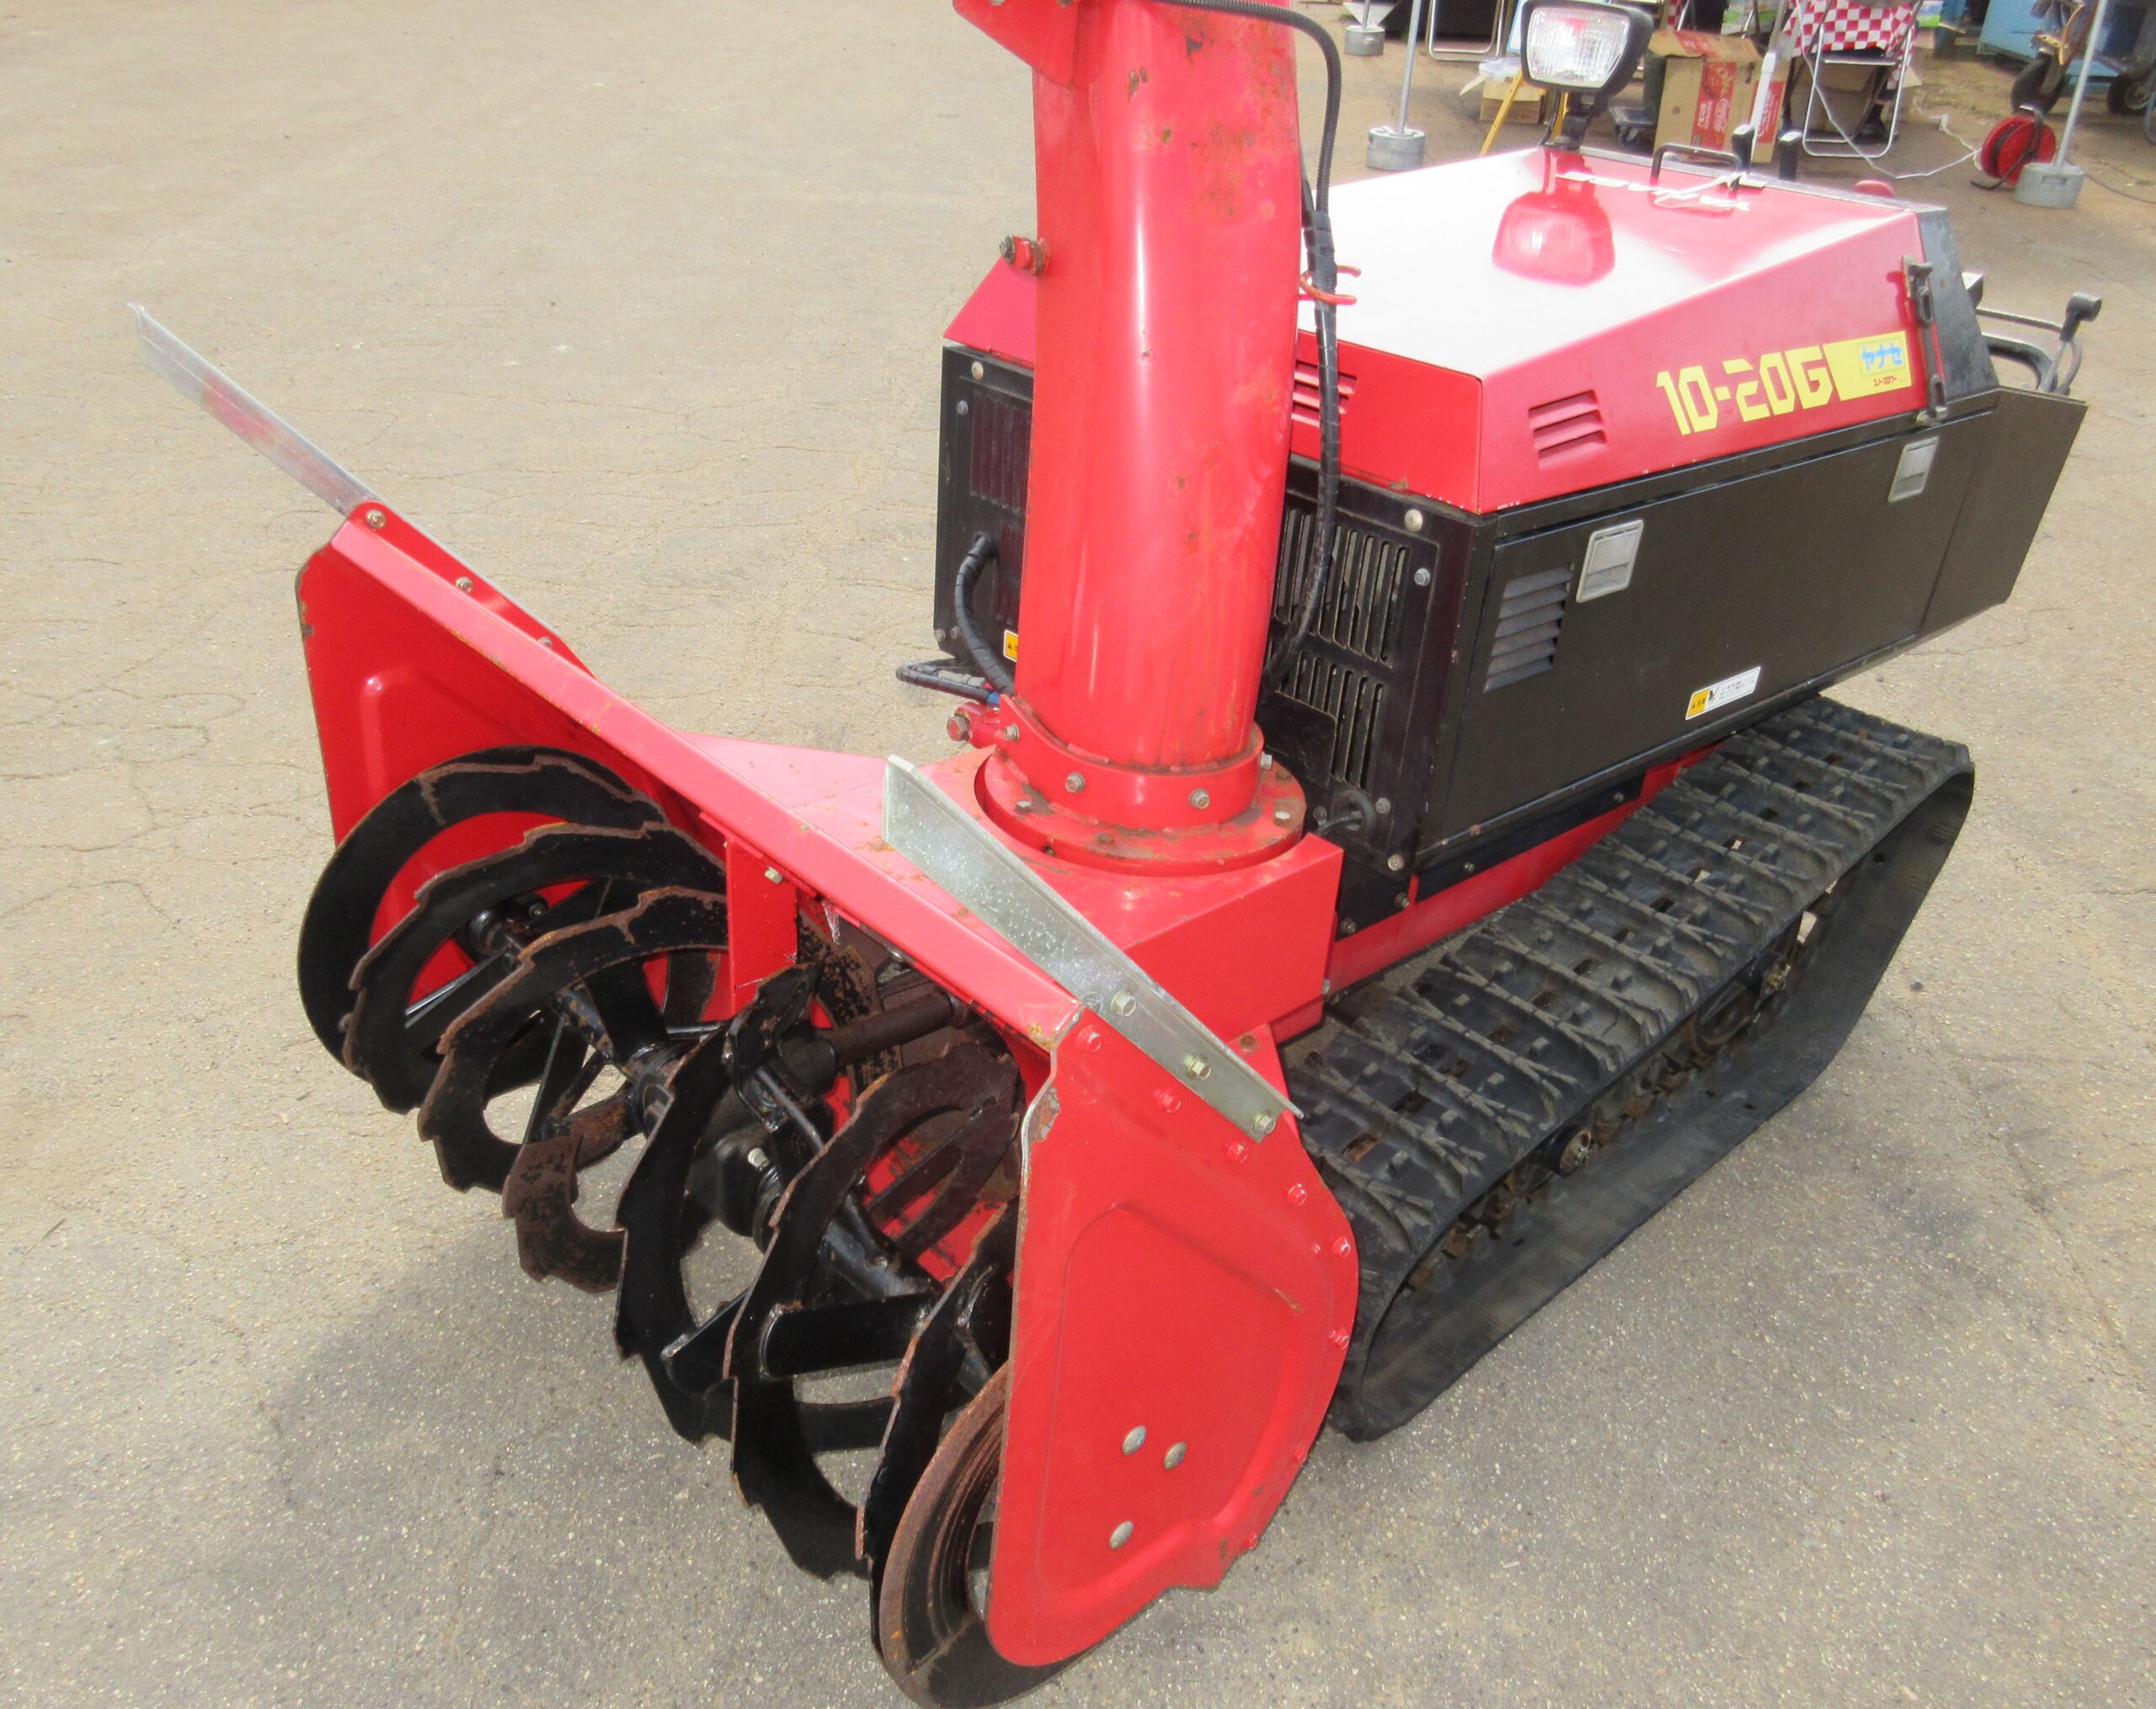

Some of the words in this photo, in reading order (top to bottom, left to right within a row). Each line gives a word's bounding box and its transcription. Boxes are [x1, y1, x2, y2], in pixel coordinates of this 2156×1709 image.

[1860, 344, 1903, 371] ヤナセ
[1656, 345, 1833, 435] 10-20G
